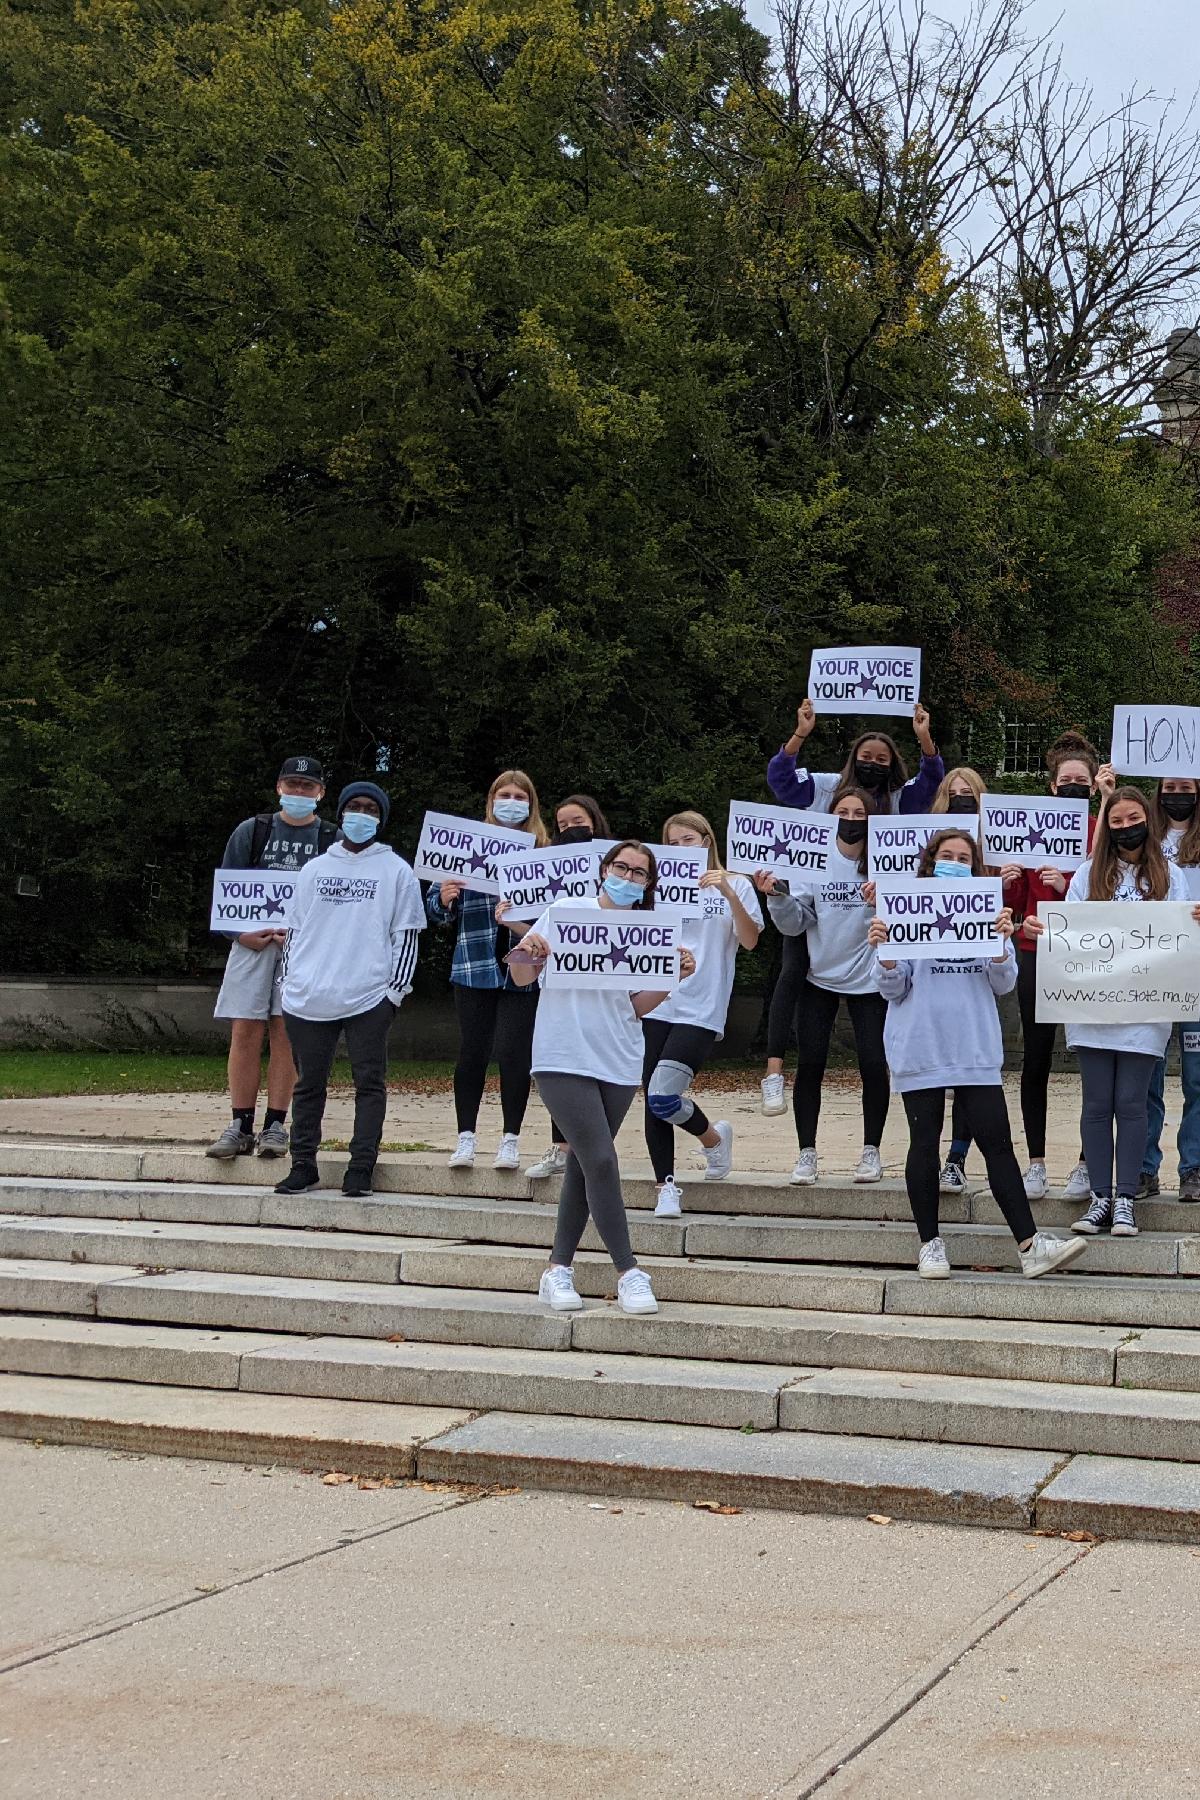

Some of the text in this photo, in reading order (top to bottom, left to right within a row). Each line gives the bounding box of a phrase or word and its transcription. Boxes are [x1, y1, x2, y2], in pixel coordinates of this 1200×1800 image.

[816, 660, 914, 678] YOUR VOICE
[813, 682, 915, 702] YOUR VOTE
[986, 809, 1081, 831] YOUR VOICE
[429, 826, 473, 851] YOUR
[734, 816, 830, 846] YOUR VOICE
[875, 829, 917, 848] YOUR
[264, 840, 319, 855] OSTO
[731, 840, 828, 870] YOUR VOTE
[984, 834, 1024, 853] YOUR
[1043, 837, 1083, 856] VOTE
[422, 850, 466, 874] YOUR
[503, 863, 546, 883] YOUR
[551, 857, 591, 877] VOIC
[872, 854, 915, 872] YOUR
[221, 882, 265, 899] YOUR
[350, 879, 379, 890] VOICE
[350, 888, 377, 900] VOTE
[658, 884, 700, 904] VOTE
[503, 887, 547, 906] YOUR
[820, 892, 850, 901] YOUR
[883, 895, 934, 915] YOUR
[942, 893, 996, 914] VOICE
[216, 904, 261, 921] YOUR
[557, 923, 674, 947] YOUR VOICE
[884, 921, 999, 943] YOUR VOTE
[1047, 912, 1190, 963] Register
[552, 951, 675, 975] YOUR VOTE
[930, 965, 983, 975] MAINE
[1131, 963, 1151, 975] at
